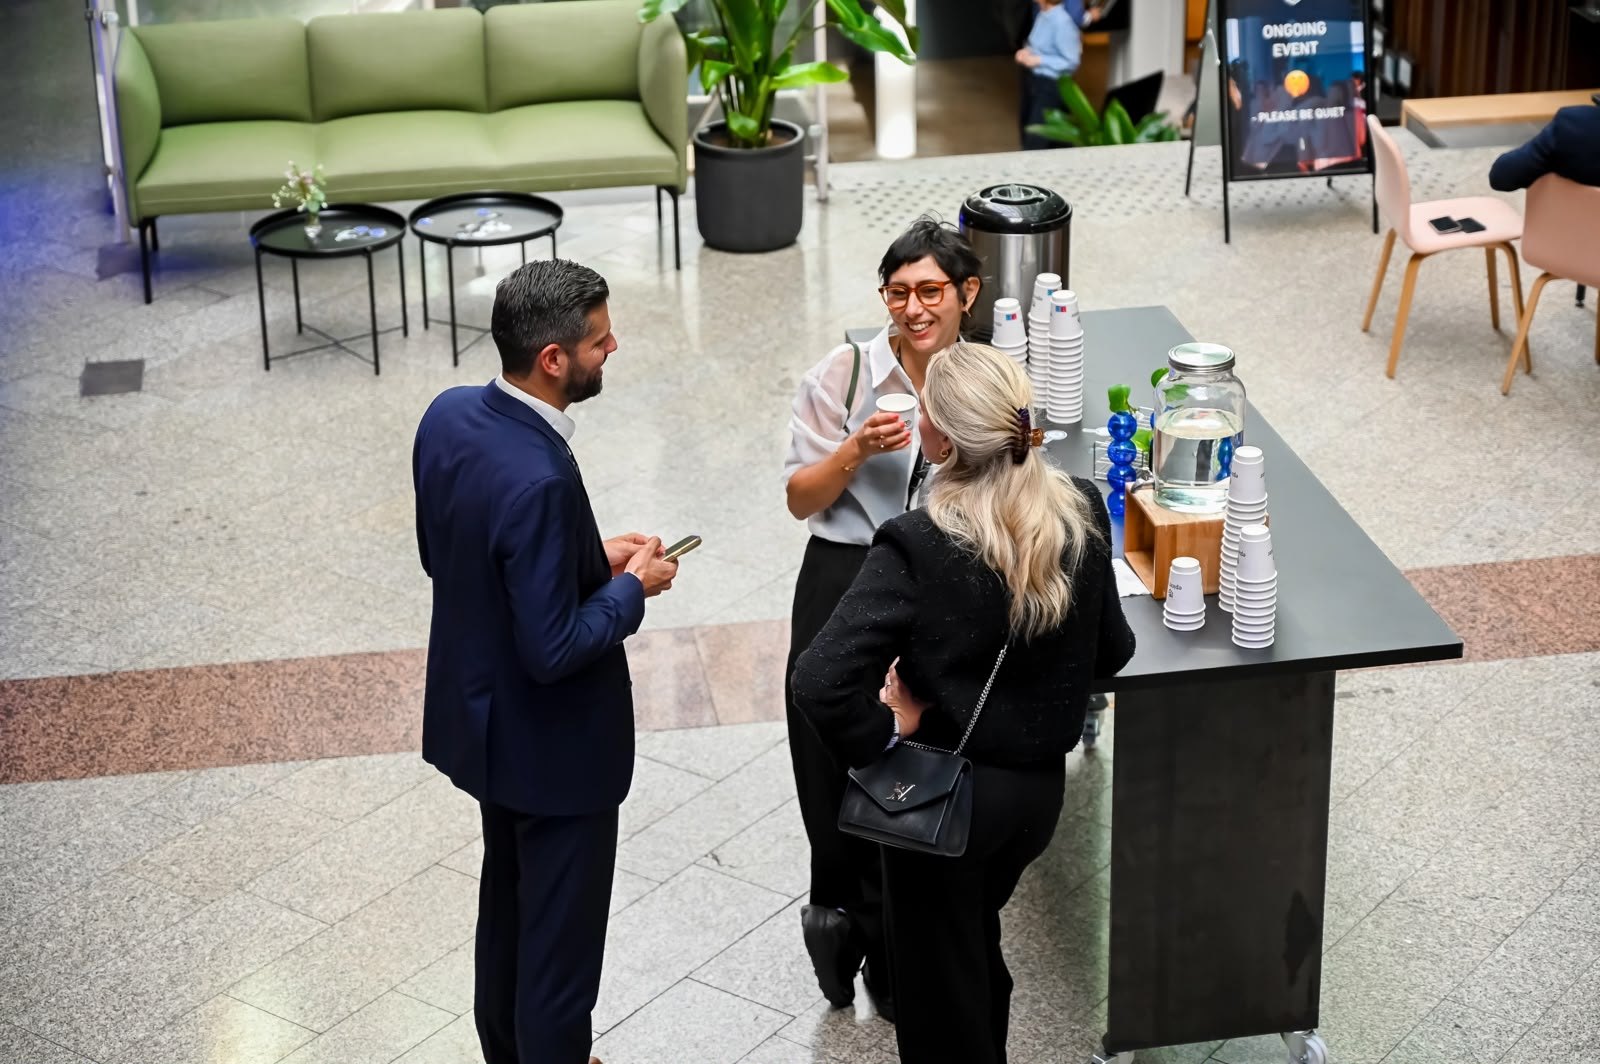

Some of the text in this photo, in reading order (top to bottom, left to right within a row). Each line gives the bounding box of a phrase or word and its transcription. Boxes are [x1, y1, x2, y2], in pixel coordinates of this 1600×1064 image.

[1262, 21, 1327, 39] ONGOING
[1272, 41, 1319, 57] EVENT
[1258, 109, 1297, 122] PLEASE
[1300, 108, 1313, 120] BE
[1314, 106, 1345, 119] QUIET
